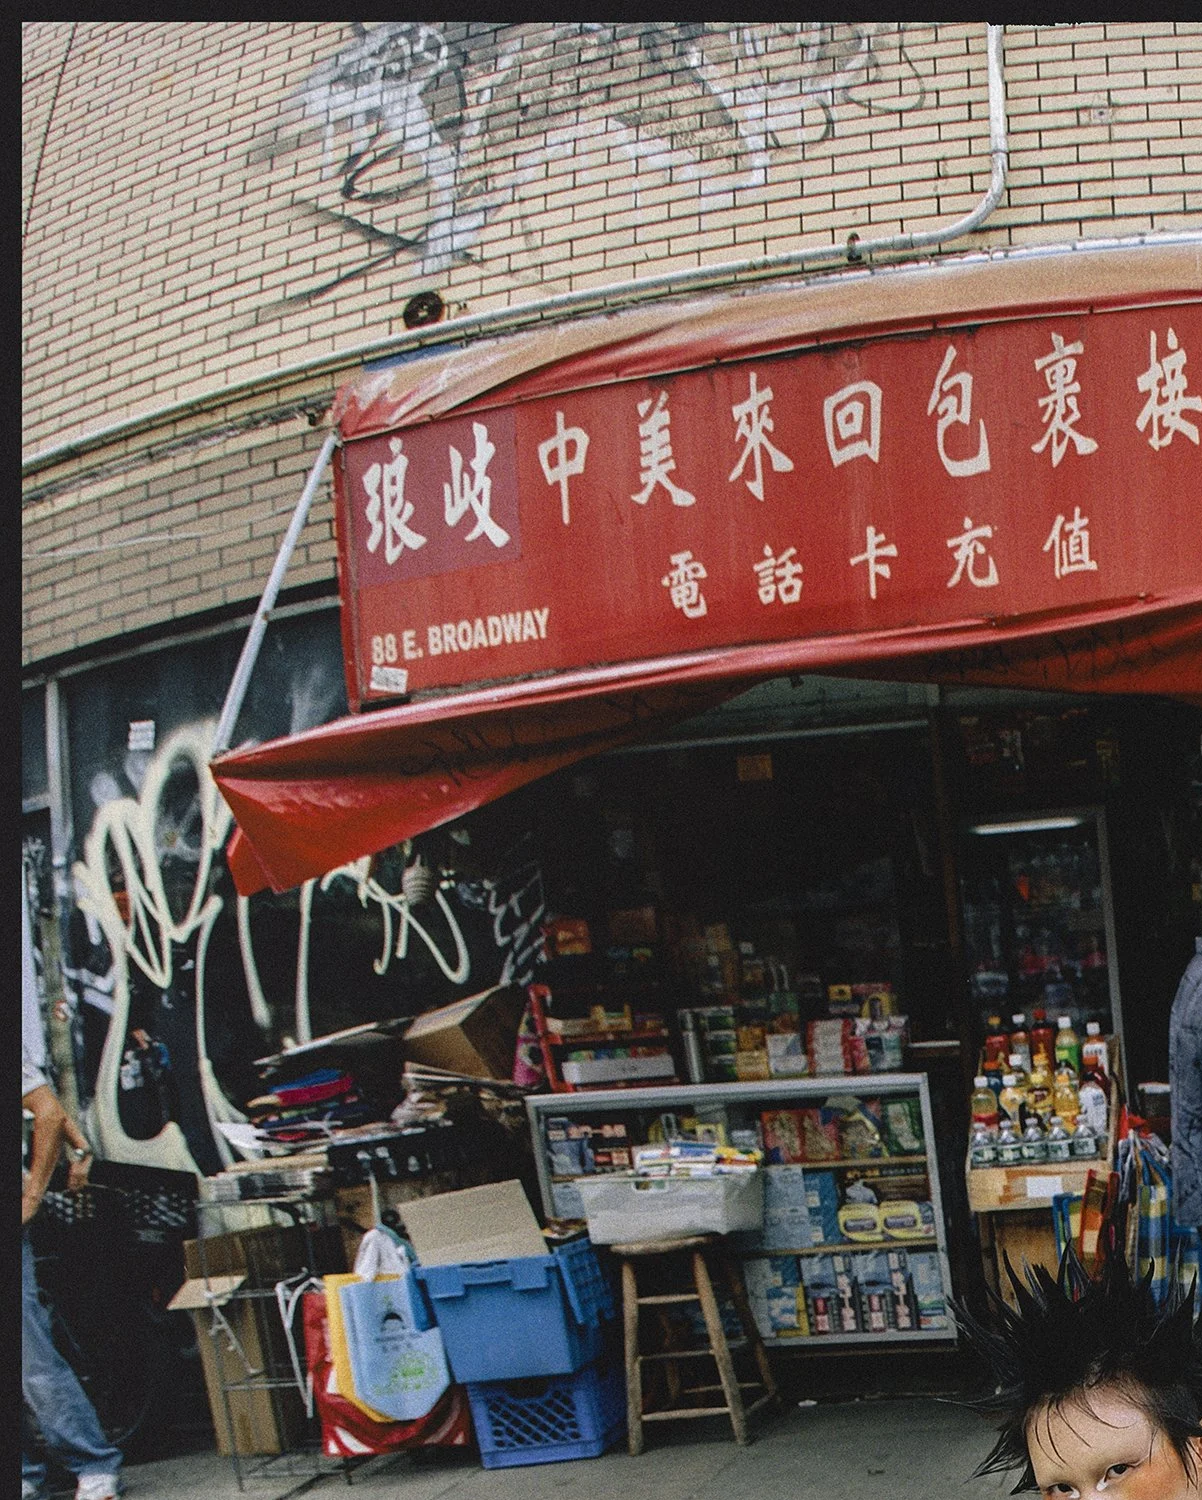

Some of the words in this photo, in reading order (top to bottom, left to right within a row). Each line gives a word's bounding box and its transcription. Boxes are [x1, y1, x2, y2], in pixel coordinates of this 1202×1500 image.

[660, 506, 1099, 619] 電話卡充值
[371, 632, 399, 665] 88
[402, 629, 424, 661] E.
[427, 607, 550, 657] BROADWAY
